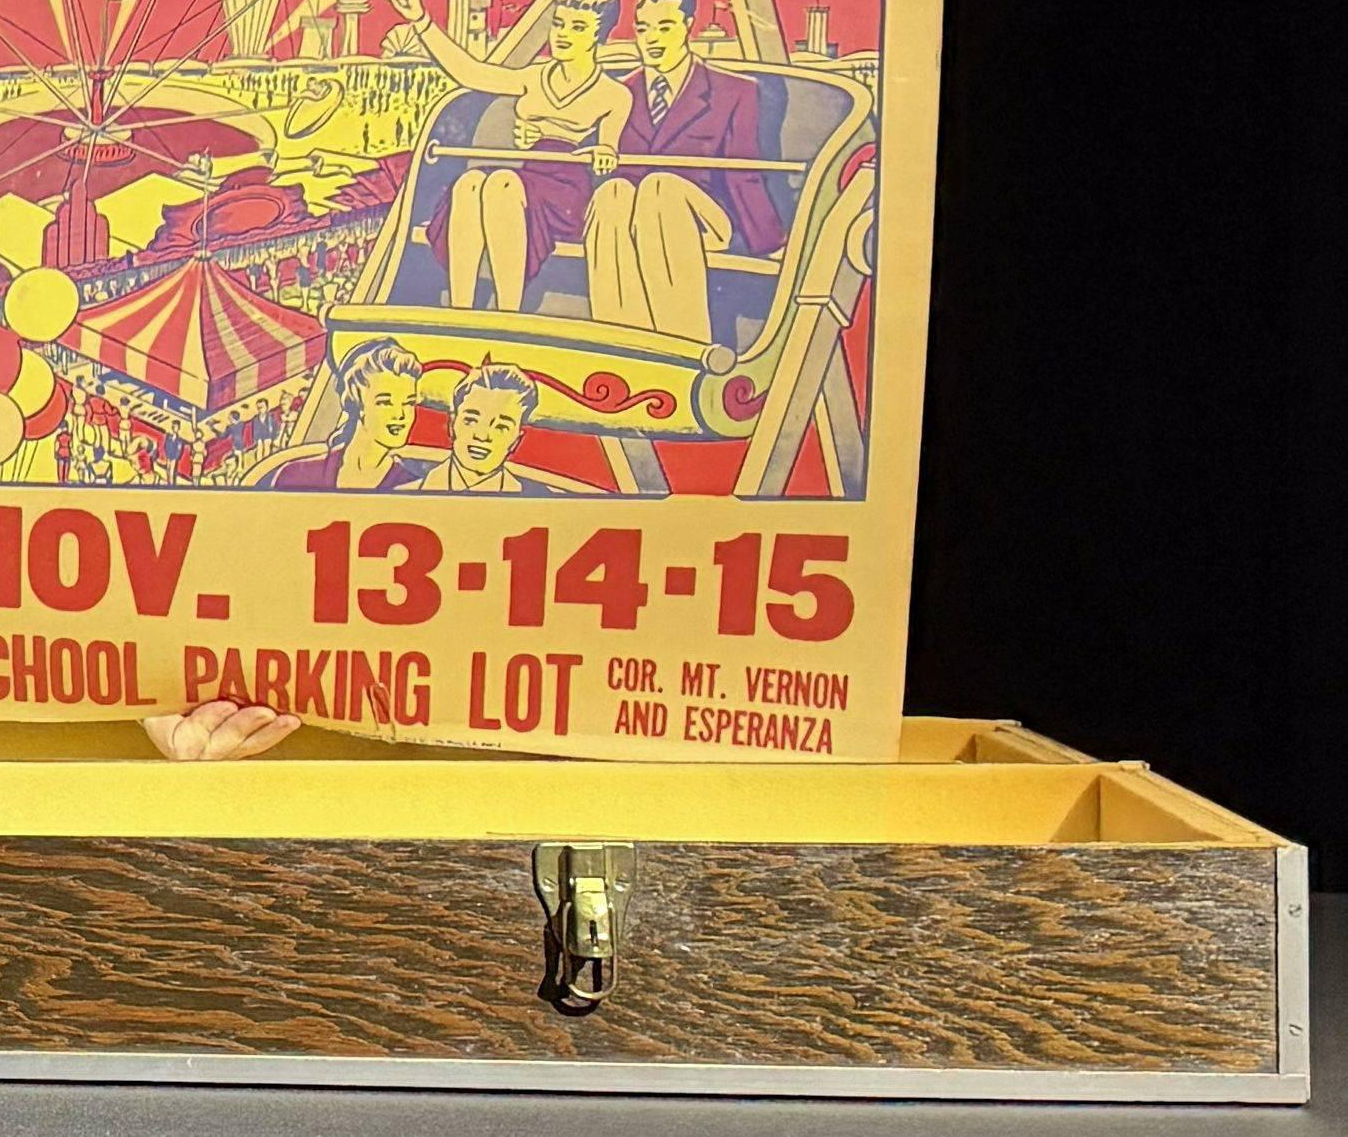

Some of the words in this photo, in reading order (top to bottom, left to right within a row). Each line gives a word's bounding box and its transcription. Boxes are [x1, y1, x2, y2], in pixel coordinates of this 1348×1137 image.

[183, 645, 432, 727] PARKING
[468, 651, 584, 737] LOT
[606, 656, 665, 694] COR.
[680, 661, 727, 700] MT.
[745, 665, 850, 712] VERNON
[614, 700, 669, 739] AND
[683, 705, 834, 756] ESPERANZA
